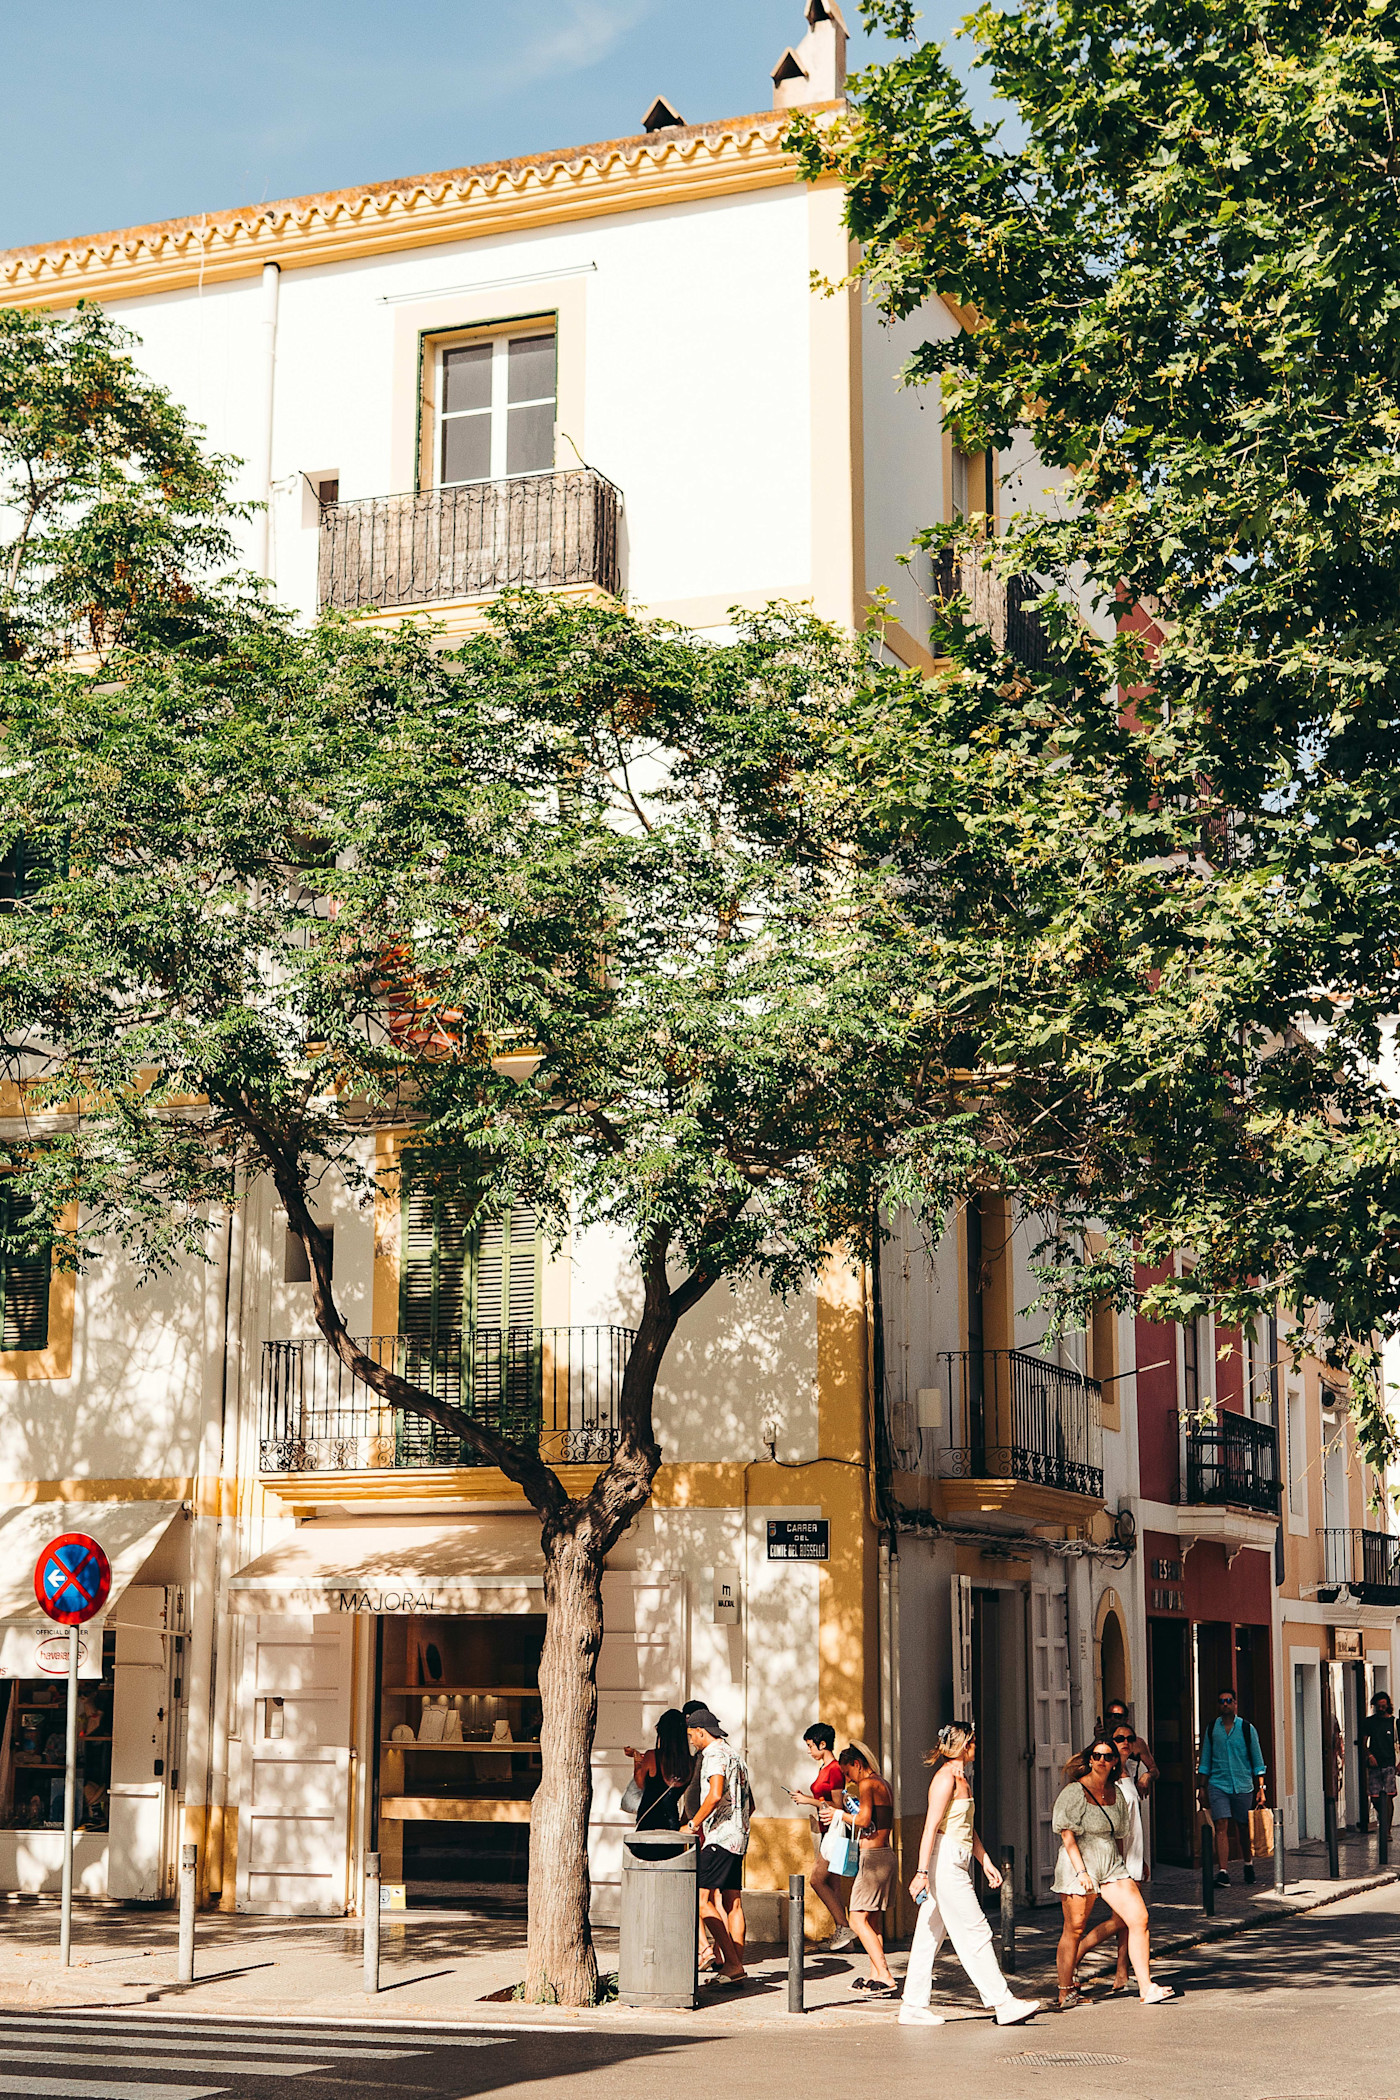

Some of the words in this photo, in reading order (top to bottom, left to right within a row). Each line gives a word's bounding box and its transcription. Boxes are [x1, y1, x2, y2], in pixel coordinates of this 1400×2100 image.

[786, 1523, 818, 1533] CARRER
[794, 1534, 810, 1542] DEL
[788, 1543, 798, 1558] DEL
[339, 1592, 441, 1612] MAJORAL
